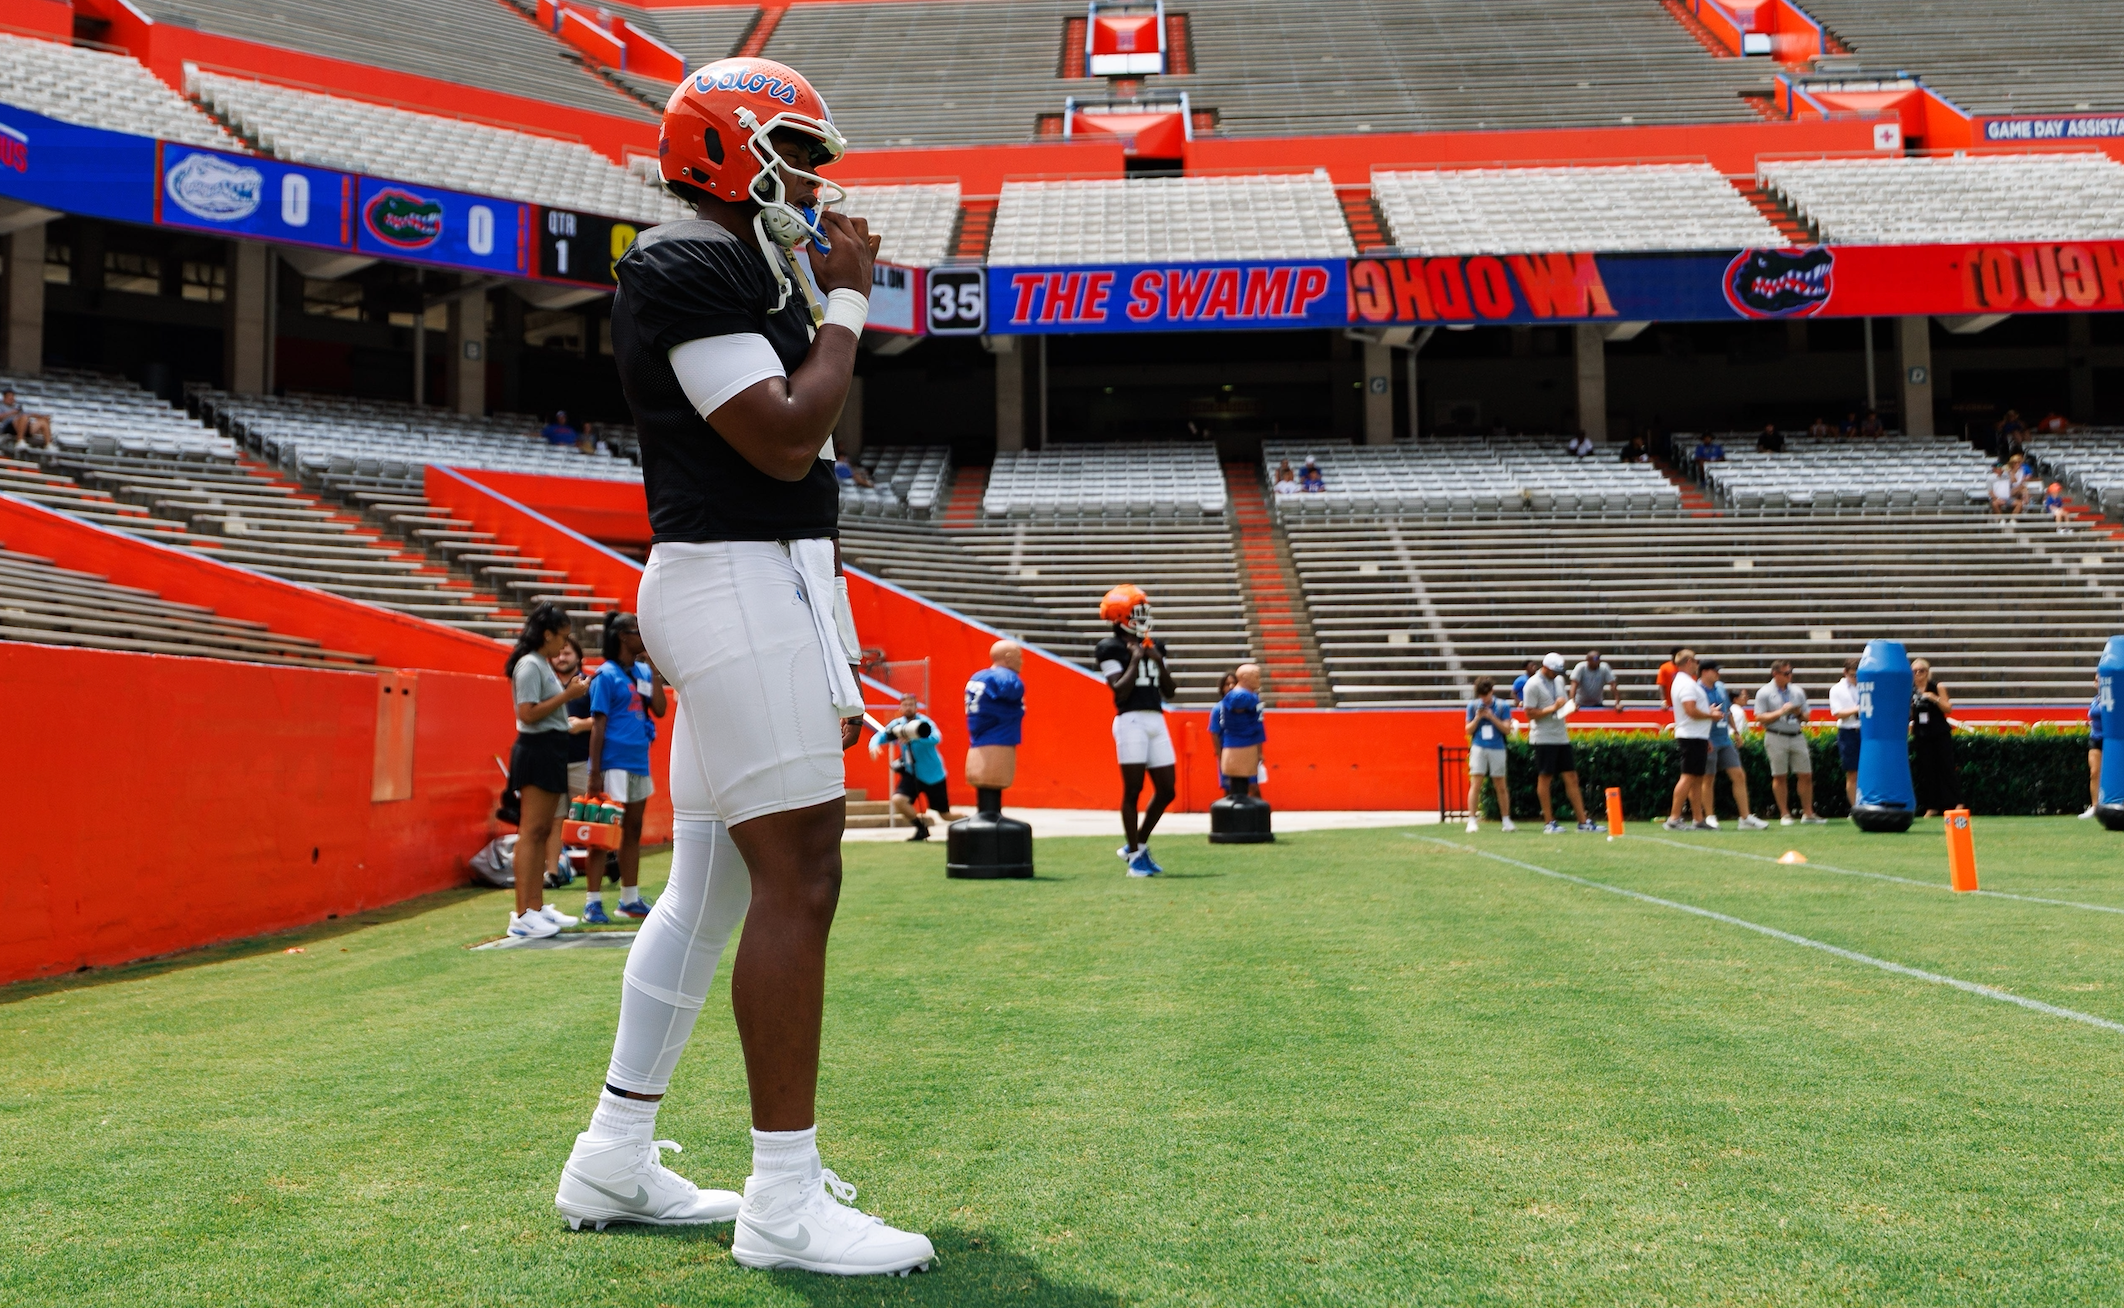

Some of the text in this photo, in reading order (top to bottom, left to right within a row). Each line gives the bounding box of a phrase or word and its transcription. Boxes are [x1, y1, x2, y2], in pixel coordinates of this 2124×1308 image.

[694, 67, 798, 106] Gators
[1988, 120, 2031, 139] GAME
[2034, 119, 2064, 137] DAY
[281, 173, 311, 227] 0
[467, 204, 495, 255] 0
[548, 210, 577, 237] QTR
[555, 239, 569, 274] 1
[931, 282, 981, 321] 35
[1010, 265, 1330, 325] THE SWAMP
[577, 825, 590, 841] G
